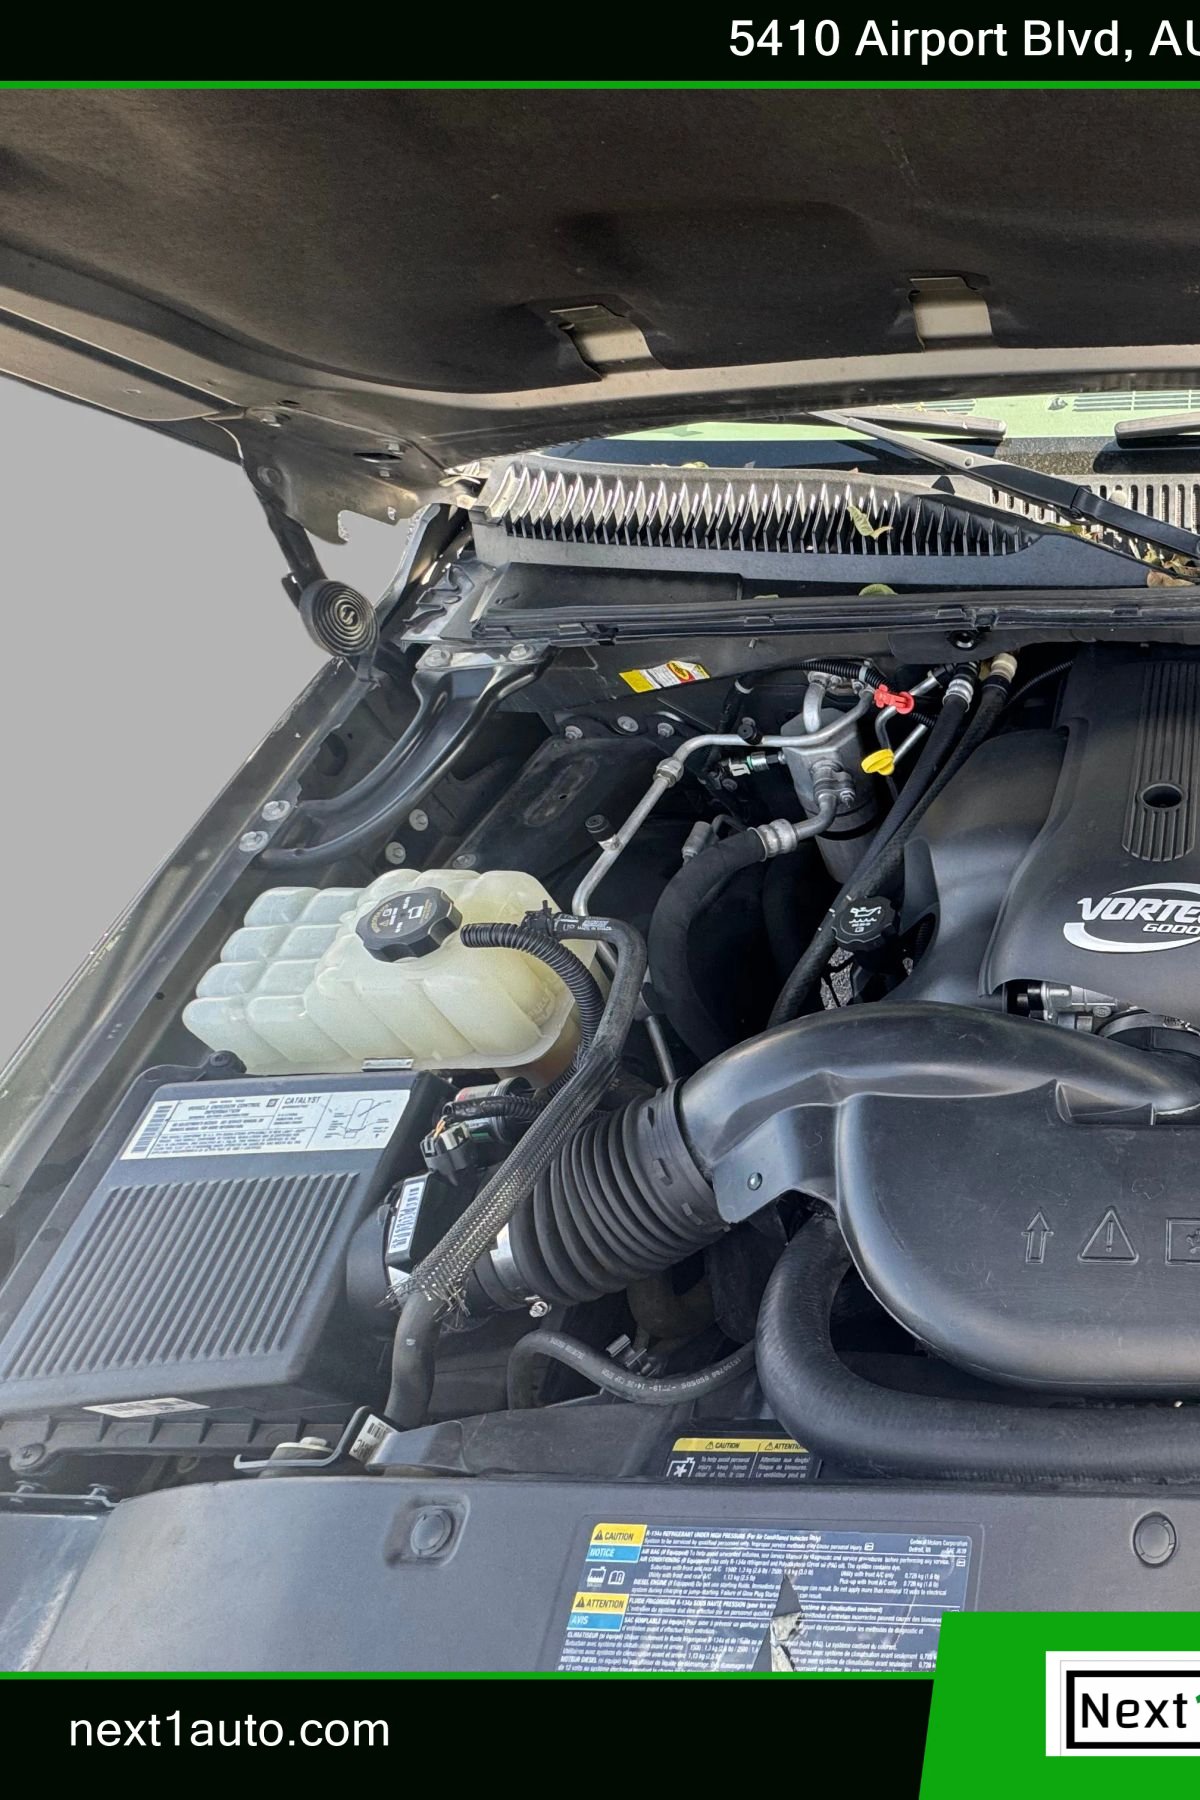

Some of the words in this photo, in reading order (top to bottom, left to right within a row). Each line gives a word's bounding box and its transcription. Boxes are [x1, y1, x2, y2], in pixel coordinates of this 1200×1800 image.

[604, 1532, 634, 1541] CAUTION
[589, 1548, 615, 1558] NOTICE
[586, 1599, 624, 1609] ATTENTION
[570, 1616, 588, 1625] AVIS
